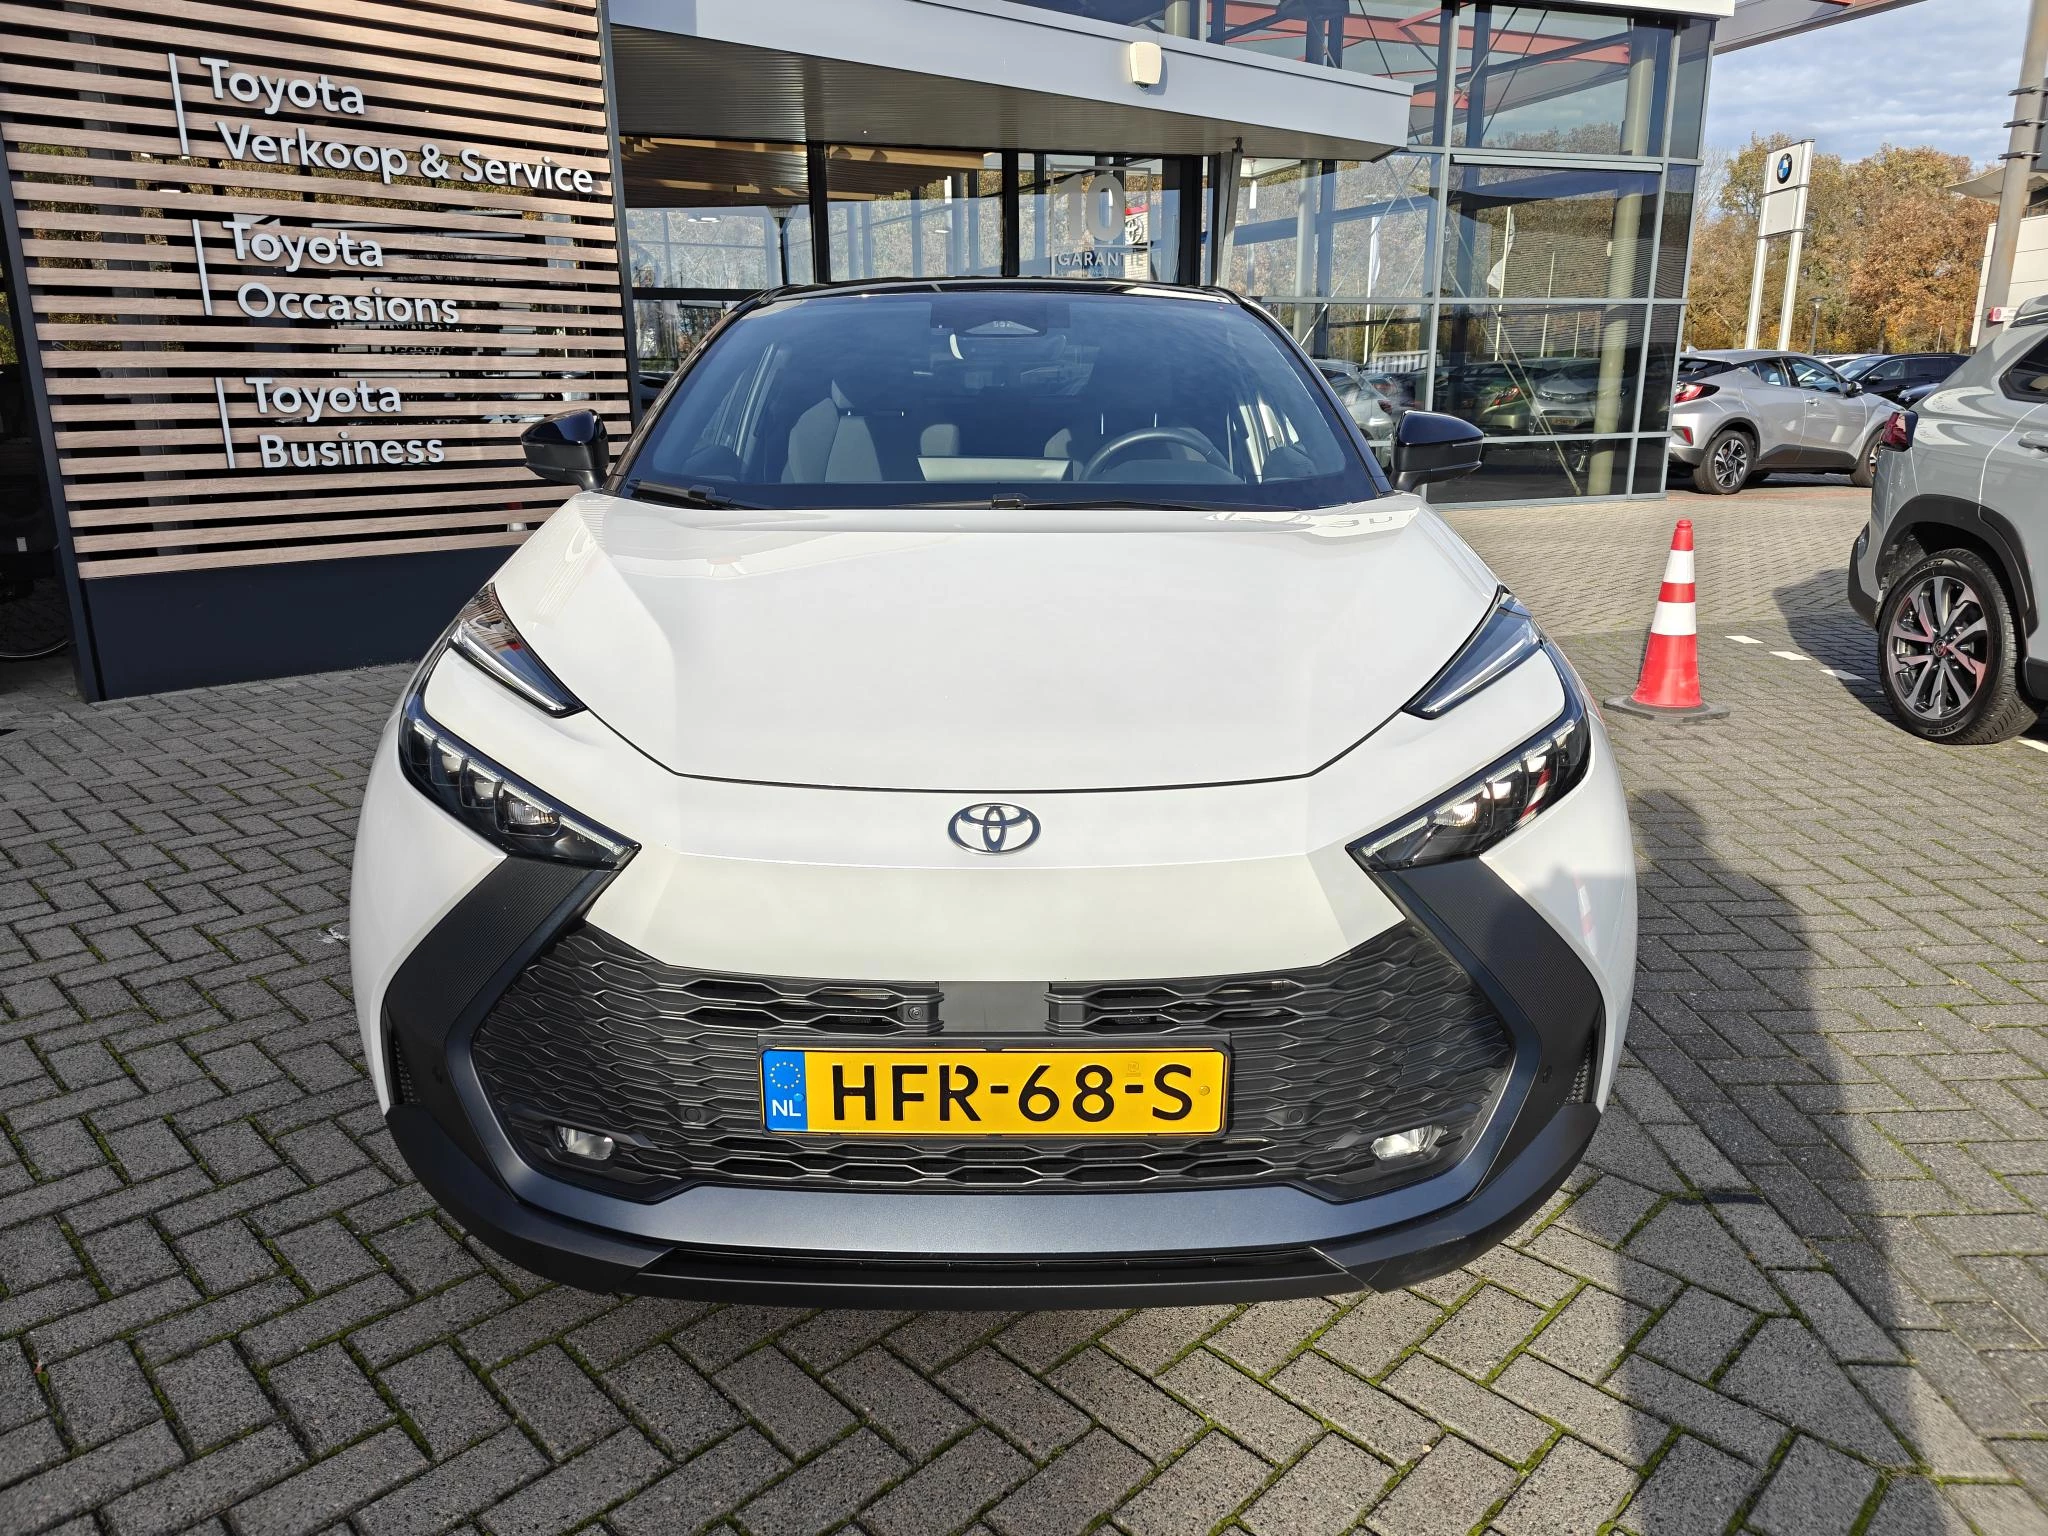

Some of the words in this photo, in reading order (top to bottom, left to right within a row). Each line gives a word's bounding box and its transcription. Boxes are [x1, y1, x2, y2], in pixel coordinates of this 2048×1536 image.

[199, 57, 366, 115] Toyota
[216, 121, 408, 184] Verkoop
[420, 143, 450, 181] &
[461, 149, 594, 193] Service
[1054, 173, 1126, 242] 10
[222, 220, 384, 271] Toyota
[1057, 252, 1144, 266] GARANTIE
[237, 282, 459, 323] Occasions
[245, 377, 402, 422] Toyota
[259, 431, 445, 468] Business
[772, 1099, 802, 1118] NL
[832, 1064, 1193, 1122] HFR-68-S
